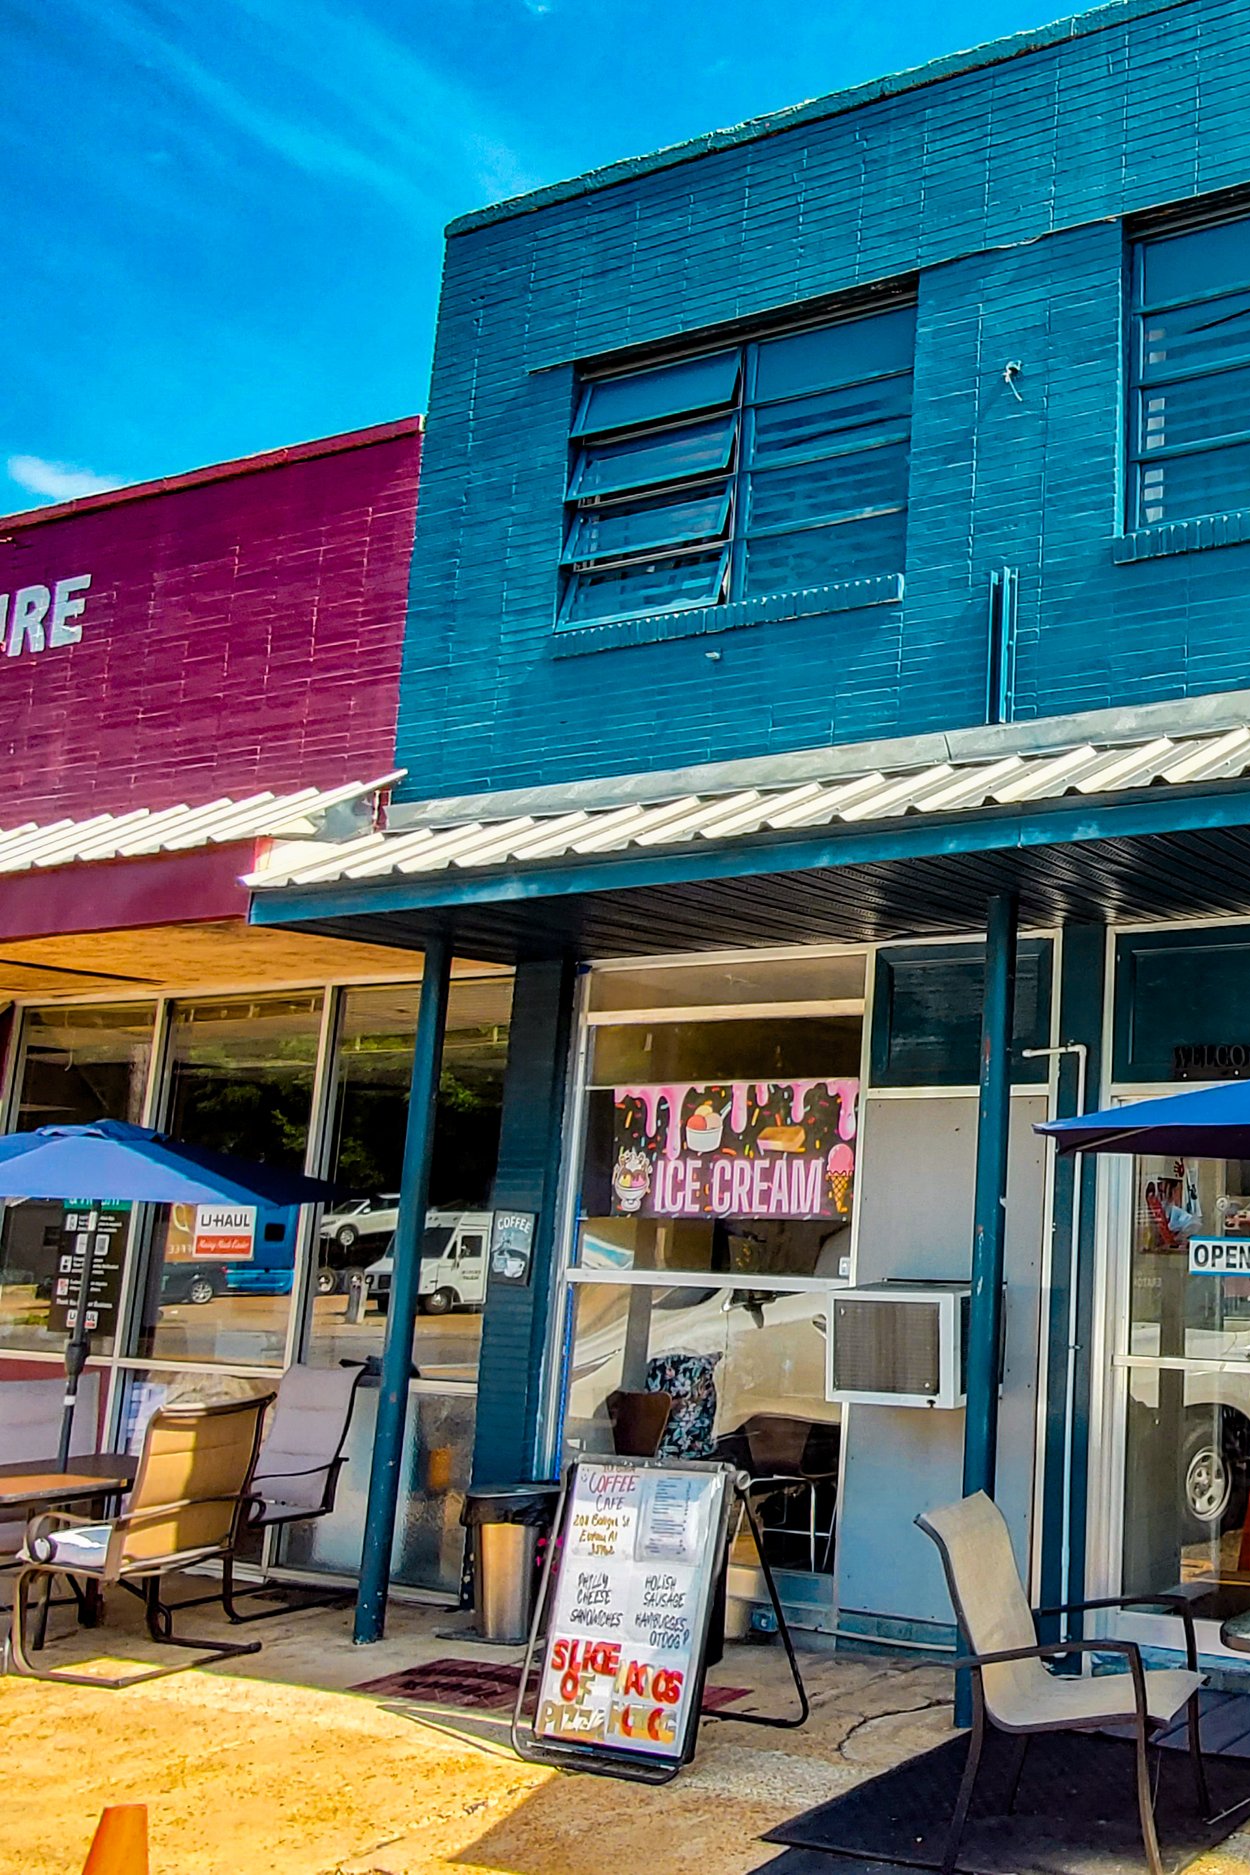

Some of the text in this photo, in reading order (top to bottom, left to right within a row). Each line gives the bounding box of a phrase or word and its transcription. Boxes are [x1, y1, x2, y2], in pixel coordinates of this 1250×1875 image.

[654, 1159, 824, 1213] ICE CREAM
[201, 1213, 250, 1227] U-HAUL
[497, 1216, 531, 1234] COFFEE
[1193, 1244, 1250, 1269] OPEN
[589, 1472, 640, 1494] COFFEE
[596, 1495, 625, 1512] CAFE
[578, 1572, 609, 1590] PHILLY
[577, 1589, 611, 1605] CHEESE
[643, 1592, 686, 1609] SAUSAGE
[570, 1608, 623, 1628] SANDWICHES
[551, 1639, 622, 1677] SLICE
[560, 1664, 596, 1706] OF
